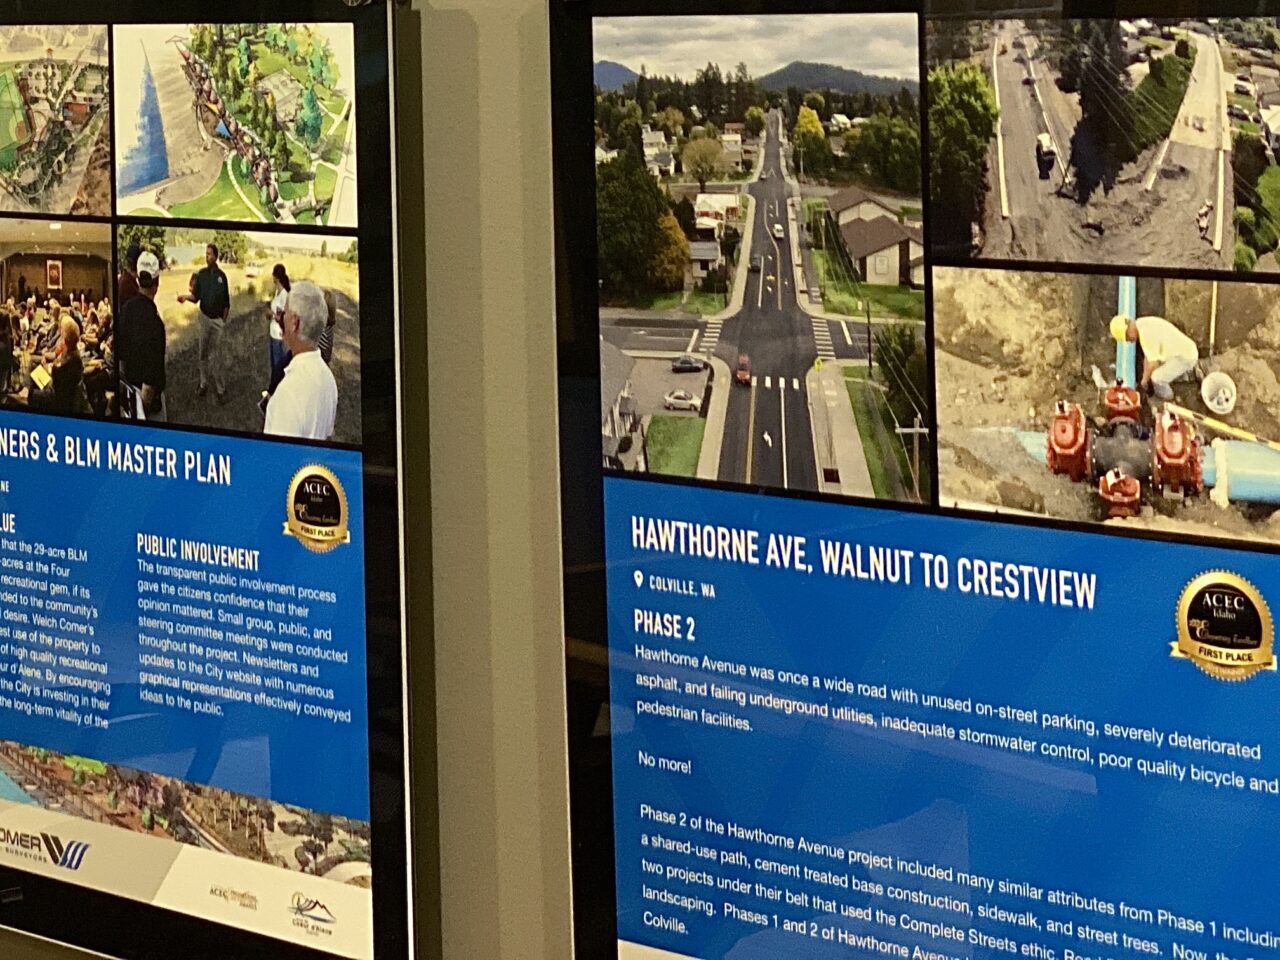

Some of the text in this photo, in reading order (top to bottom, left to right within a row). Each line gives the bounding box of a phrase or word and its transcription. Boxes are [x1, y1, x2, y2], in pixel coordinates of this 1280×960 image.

[46, 433, 58, 462] &
[65, 436, 100, 468] BLM
[108, 441, 177, 478] MASTER
[184, 450, 230, 485] PLAN
[304, 482, 330, 496] ACEC
[1, 538, 16, 551] that
[19, 541, 32, 554] the
[34, 542, 65, 559] 29-acre
[67, 548, 87, 562] BLM
[137, 533, 259, 570] PUBLIC INVOLVEMENT
[631, 515, 1096, 609] HAWTHORNE AVE, WALNUT TO CRESTVIEW
[700, 583, 715, 598] WA
[1202, 592, 1244, 610] ACEC
[634, 608, 695, 641] PHASE 2
[1213, 608, 1236, 620] Idaho
[1198, 646, 1254, 662] FIRST PLACE
[636, 700, 753, 732] pedestrian facilities.
[638, 750, 691, 774] No more!
